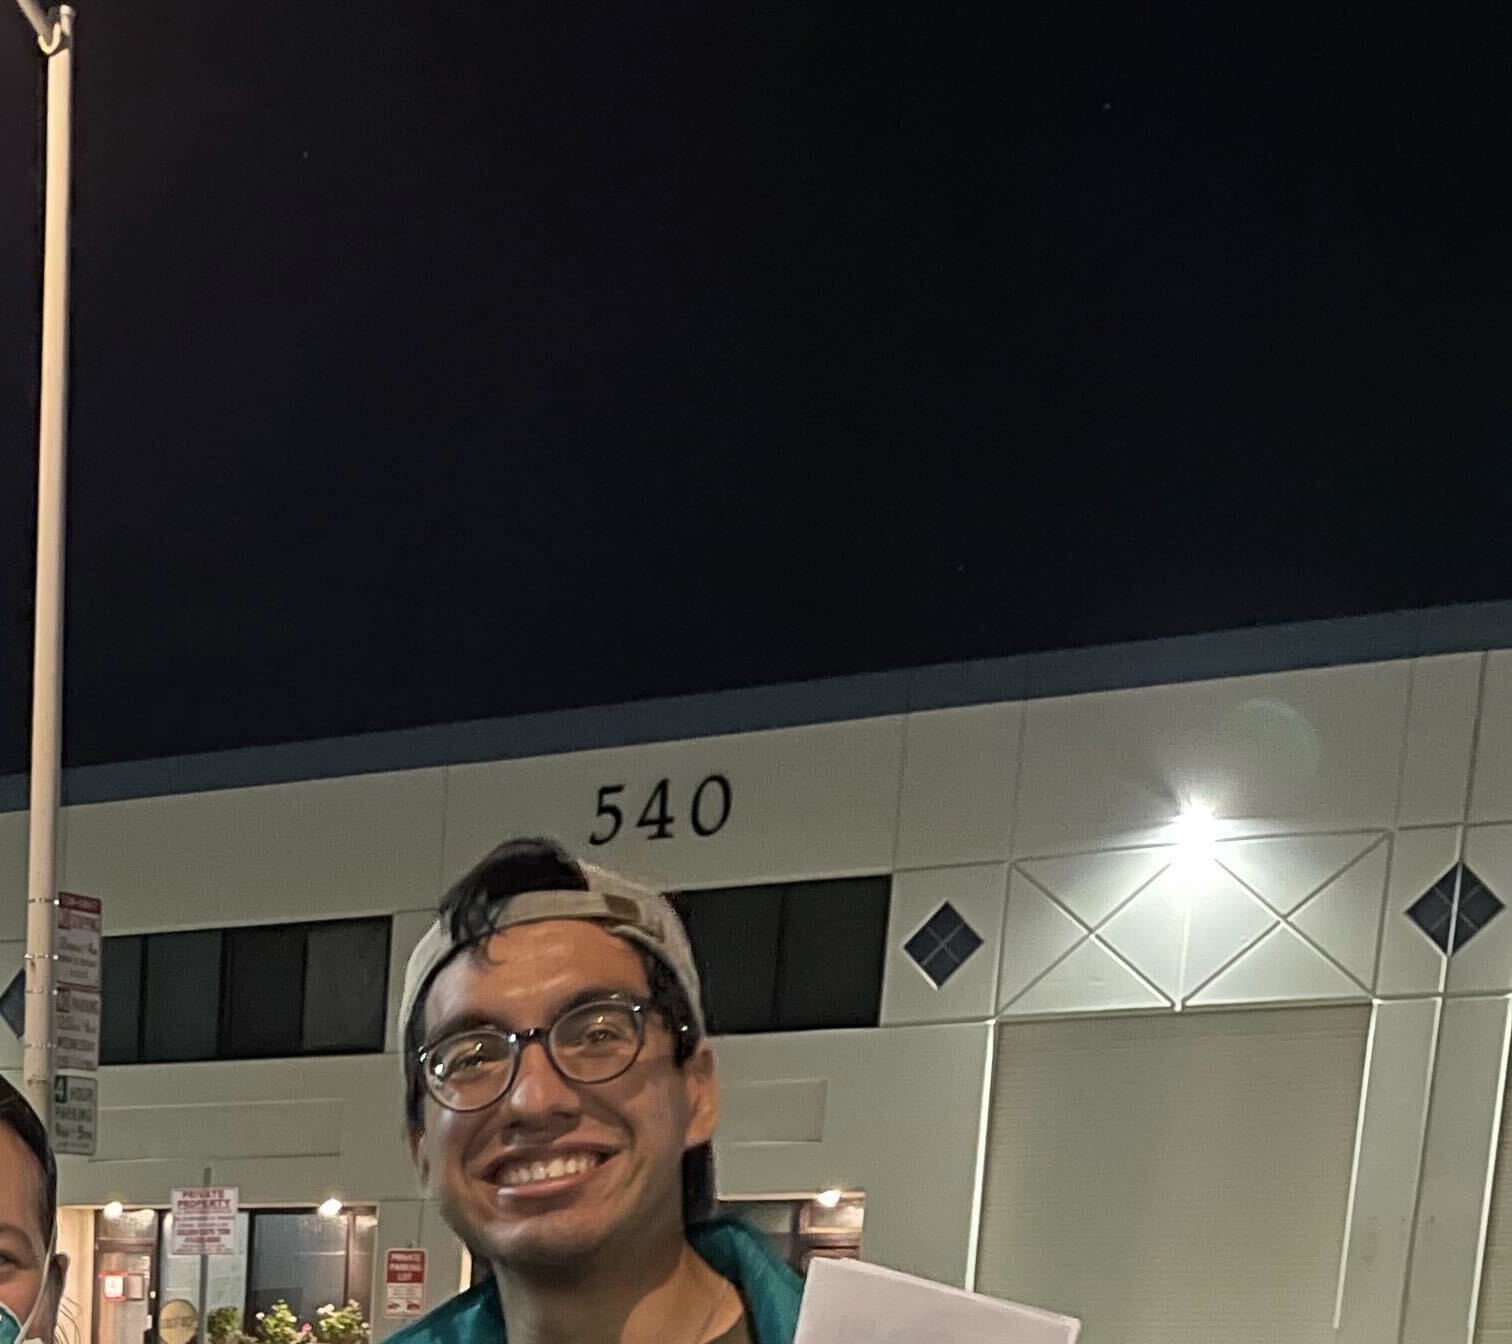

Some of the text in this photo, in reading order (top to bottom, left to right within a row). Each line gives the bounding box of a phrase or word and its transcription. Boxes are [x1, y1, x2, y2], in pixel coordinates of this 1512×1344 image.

[588, 774, 732, 846] 540
[182, 1189, 224, 1199] PRIVATE
[177, 1199, 231, 1210] PROPERTY
